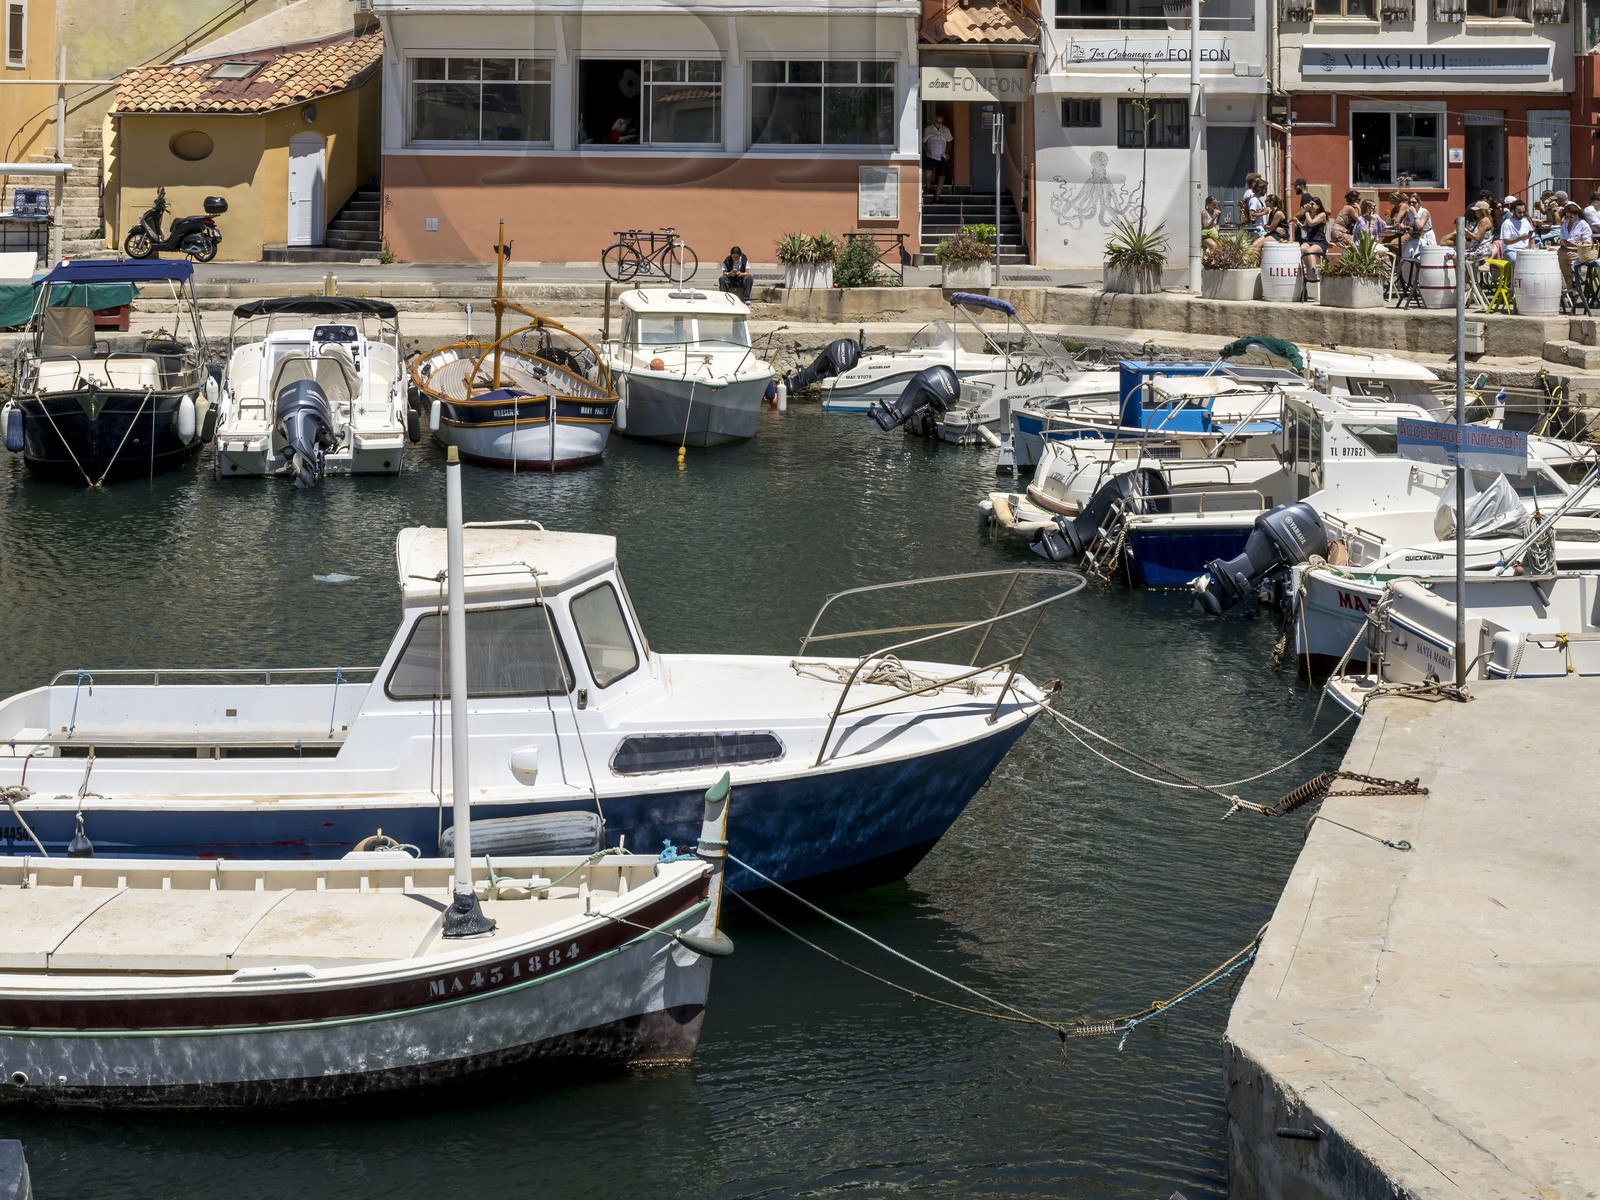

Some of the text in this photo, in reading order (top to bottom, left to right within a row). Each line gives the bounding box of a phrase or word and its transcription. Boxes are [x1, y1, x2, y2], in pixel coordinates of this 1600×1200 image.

[1154, 51, 1165, 59] de
[1168, 48, 1230, 62] FOFON
[927, 76, 1024, 94] chez FONFON
[1400, 421, 1524, 451] ACCOSTAGE INTERDIT
[1330, 447, 1366, 457] TL 877621
[1289, 521, 1307, 545] YAMAHA
[1405, 554, 1444, 562] QUICKSILVER
[1416, 643, 1451, 670] SANTA MARIA
